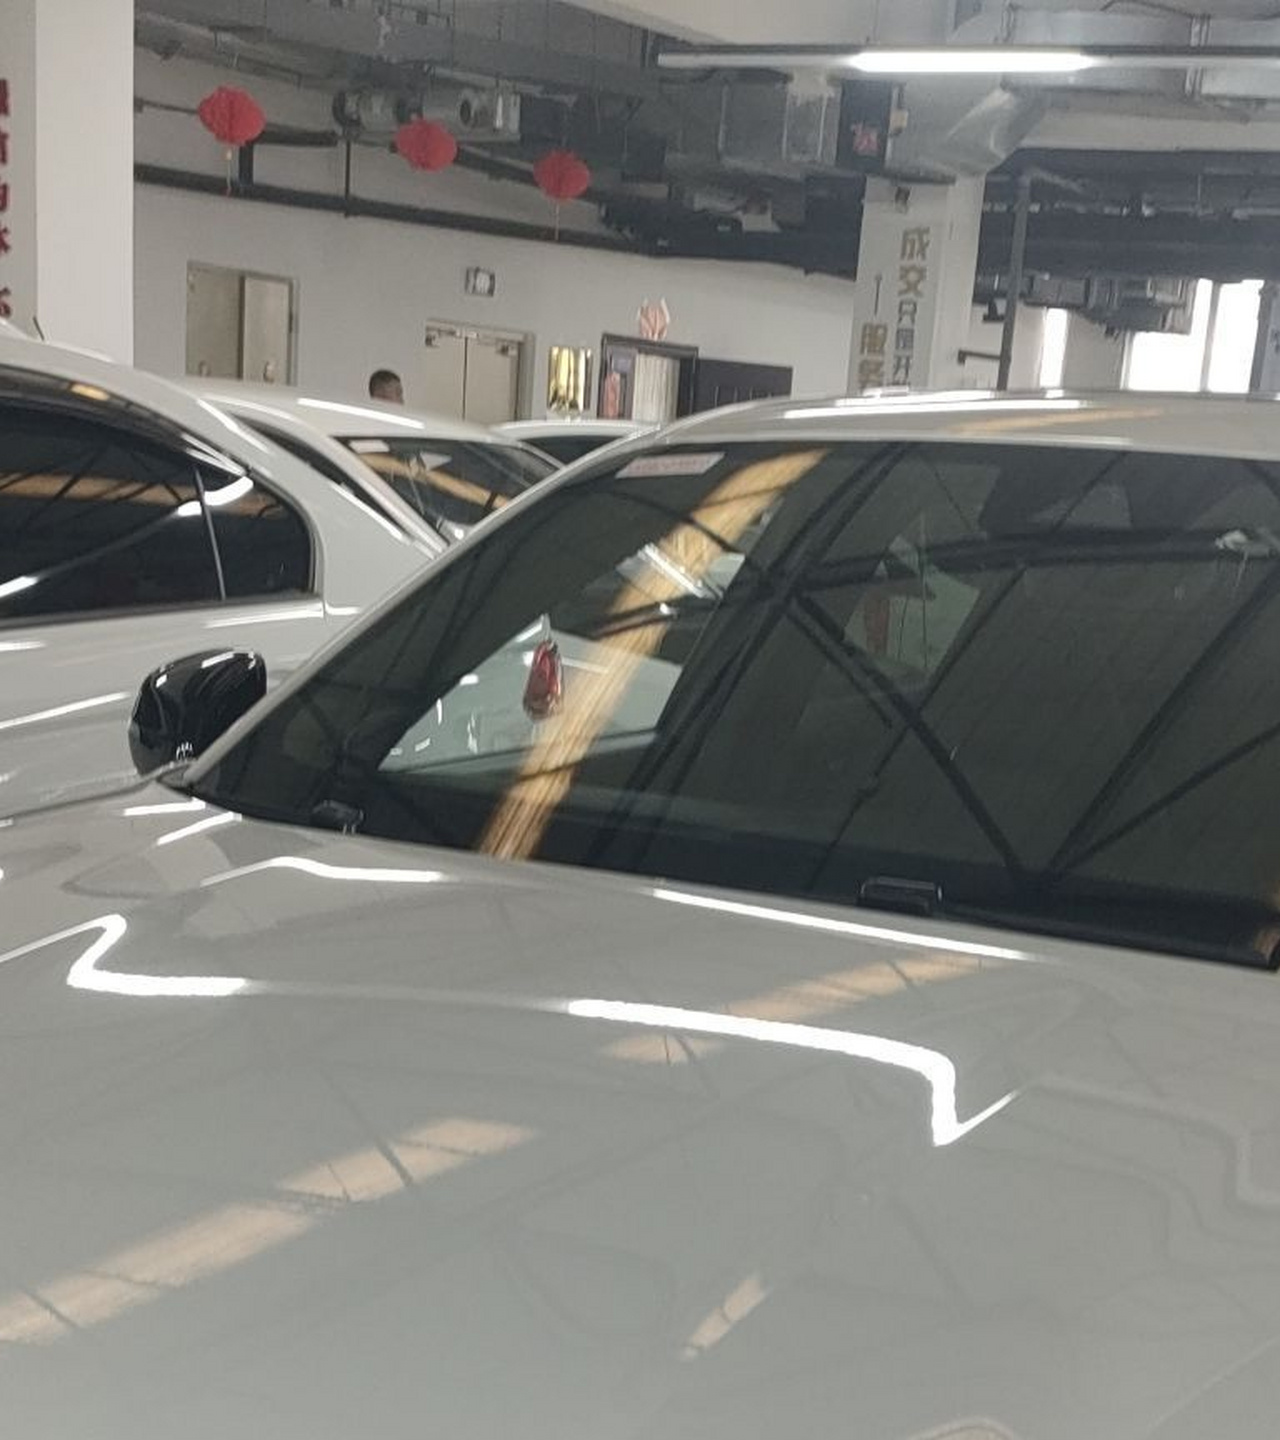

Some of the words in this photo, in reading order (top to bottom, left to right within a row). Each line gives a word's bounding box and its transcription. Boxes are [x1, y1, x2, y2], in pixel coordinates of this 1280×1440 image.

[893, 227, 930, 387] 成交只是开
